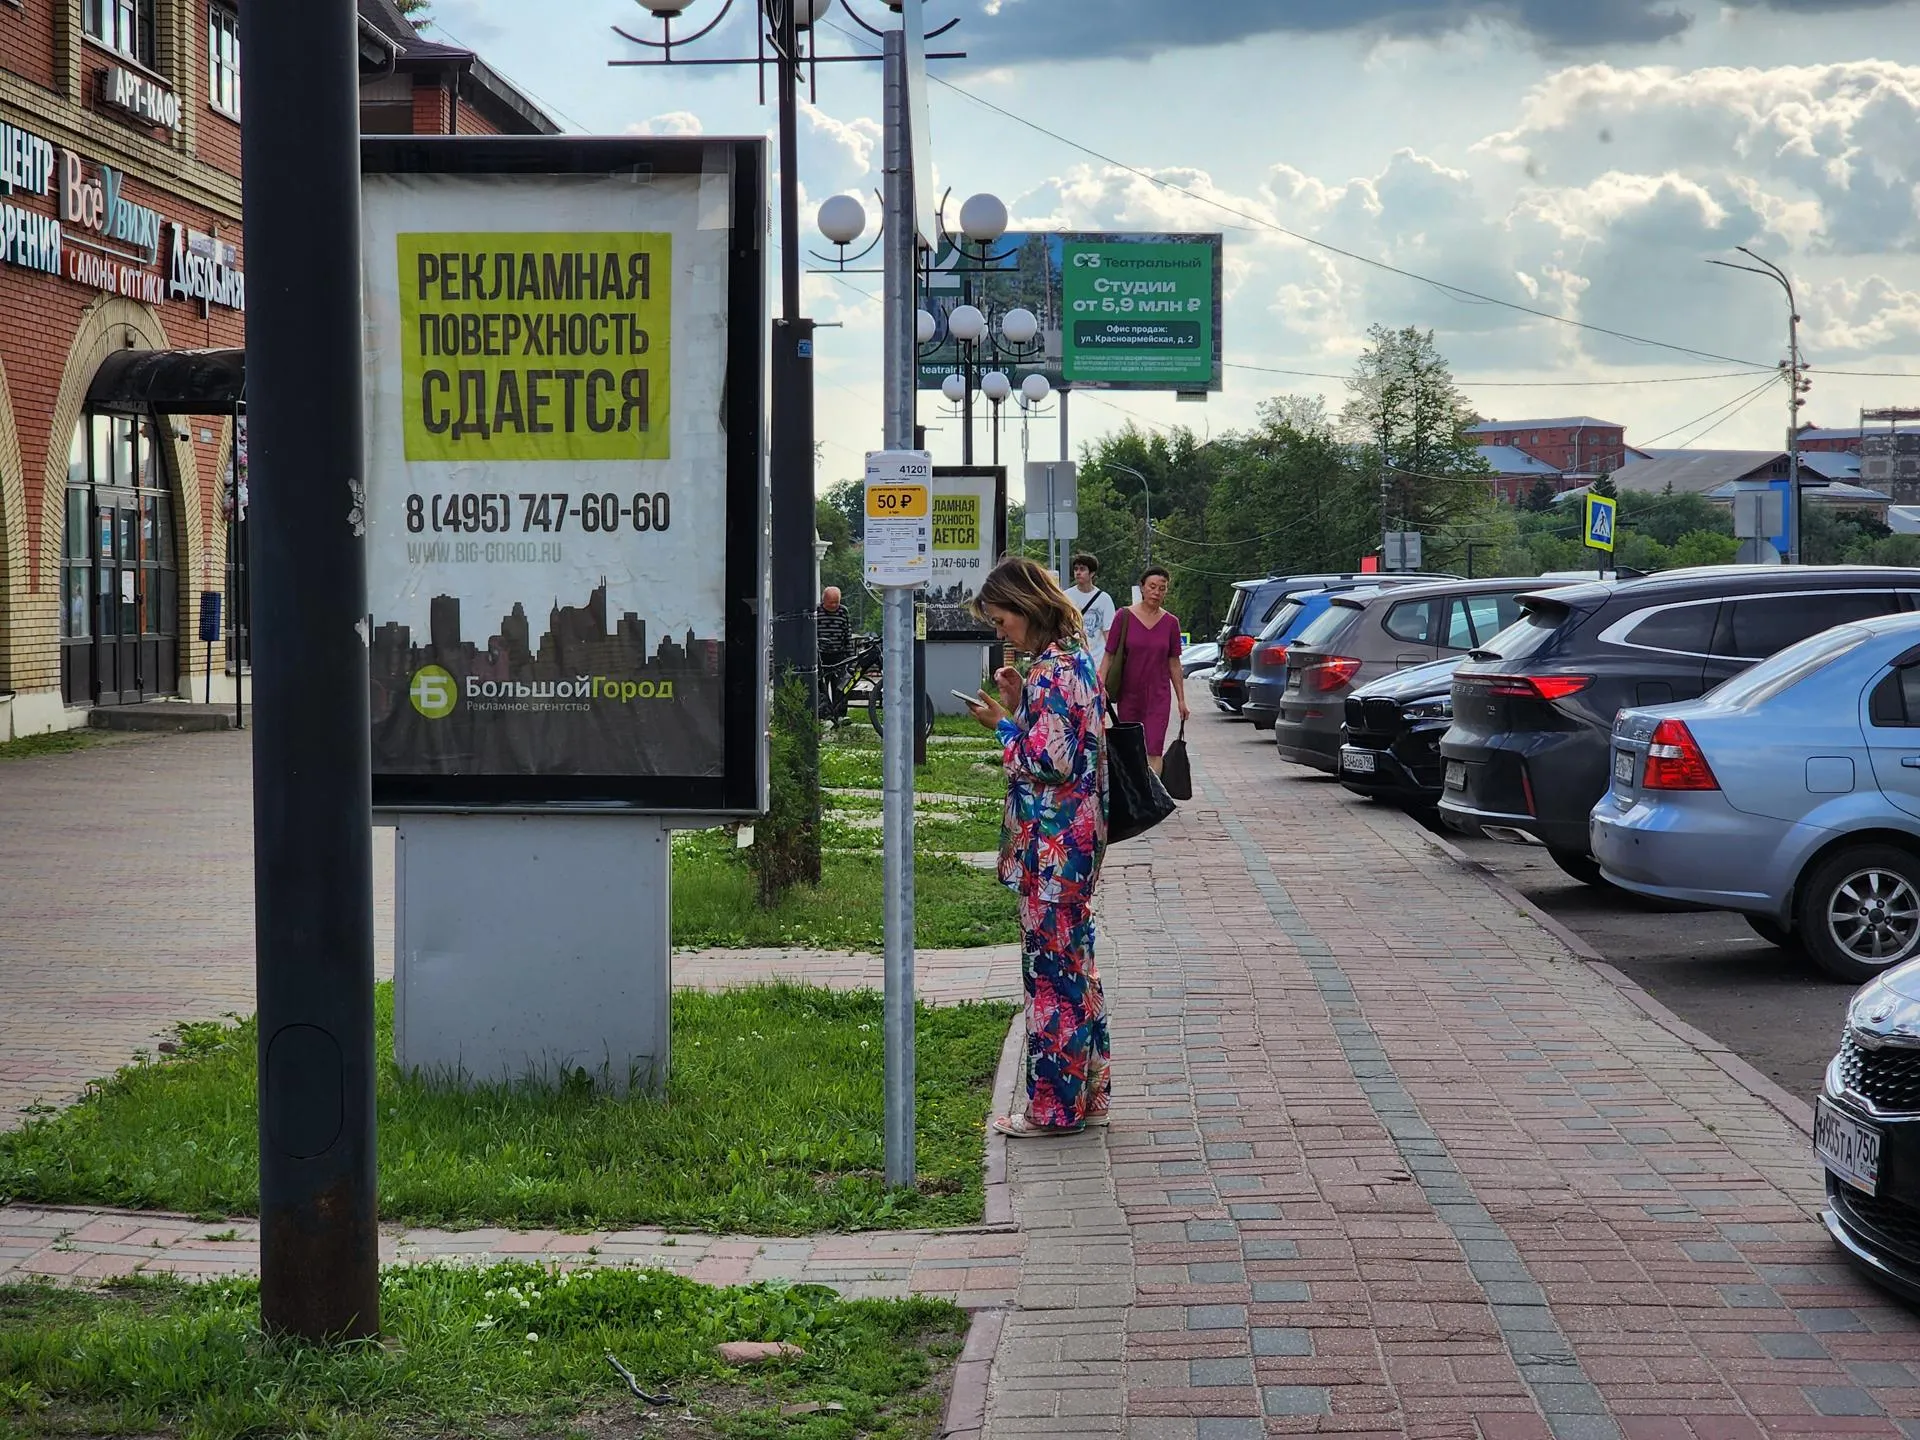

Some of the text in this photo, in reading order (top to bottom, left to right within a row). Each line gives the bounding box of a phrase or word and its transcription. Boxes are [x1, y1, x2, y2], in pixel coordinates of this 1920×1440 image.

[115, 67, 181, 132] АРТ-КАФЕ
[0, 122, 53, 196] ЦЕНТР
[1103, 257, 1201, 269] Театральный
[69, 251, 164, 306] САЛОНЫ ОПТИКИ
[418, 252, 650, 301] РЕКЛАМНАЯ
[1094, 278, 1176, 294] Студии
[1073, 300, 1097, 312] от
[1102, 297, 1134, 314] 5,9
[1138, 300, 1182, 312] млн
[419, 312, 649, 356] ПОВЕРХНОСТЬ
[1106, 325, 1168, 335] Офис продаж:
[1080, 335, 1093, 344] ул.
[1188, 335, 1193, 343] 2
[421, 368, 649, 441] СДАЕТСЯ
[899, 465, 927, 474] 41201
[877, 494, 897, 509] 50
[932, 499, 975, 512] ЛАМНАЯ
[406, 492, 670, 533] 8 (495) 747-60-60
[932, 514, 975, 526] ЕРХНОСТЬ
[932, 528, 975, 544] АЕТСЯ
[407, 541, 562, 564] WWW.BIG-GOROD.RU
[466, 700, 591, 712] Рекламное агентство
[1857, 1130, 1877, 1166] 750
